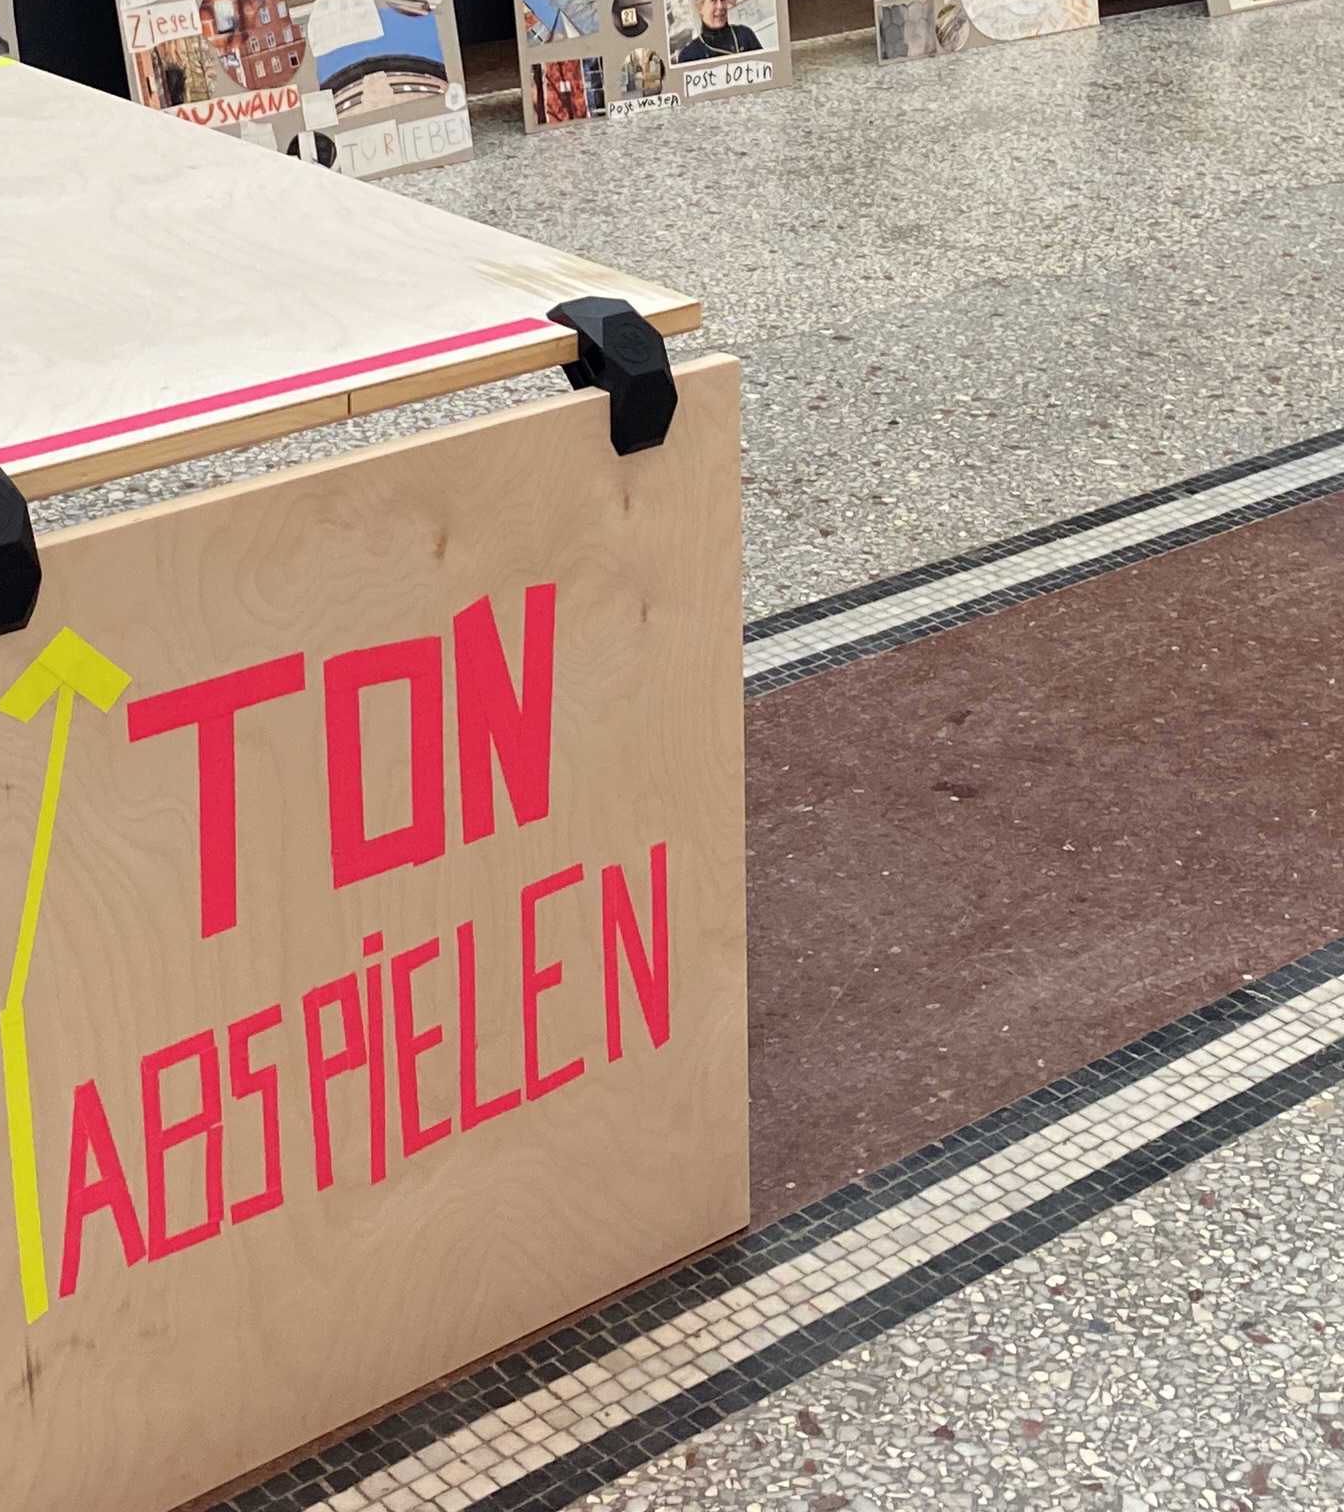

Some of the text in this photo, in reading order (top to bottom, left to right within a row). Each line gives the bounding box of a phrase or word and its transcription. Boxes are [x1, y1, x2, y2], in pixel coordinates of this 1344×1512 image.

[126, 9, 199, 49] Ziegel
[623, 10, 634, 23] 27
[126, 582, 557, 940] TON
